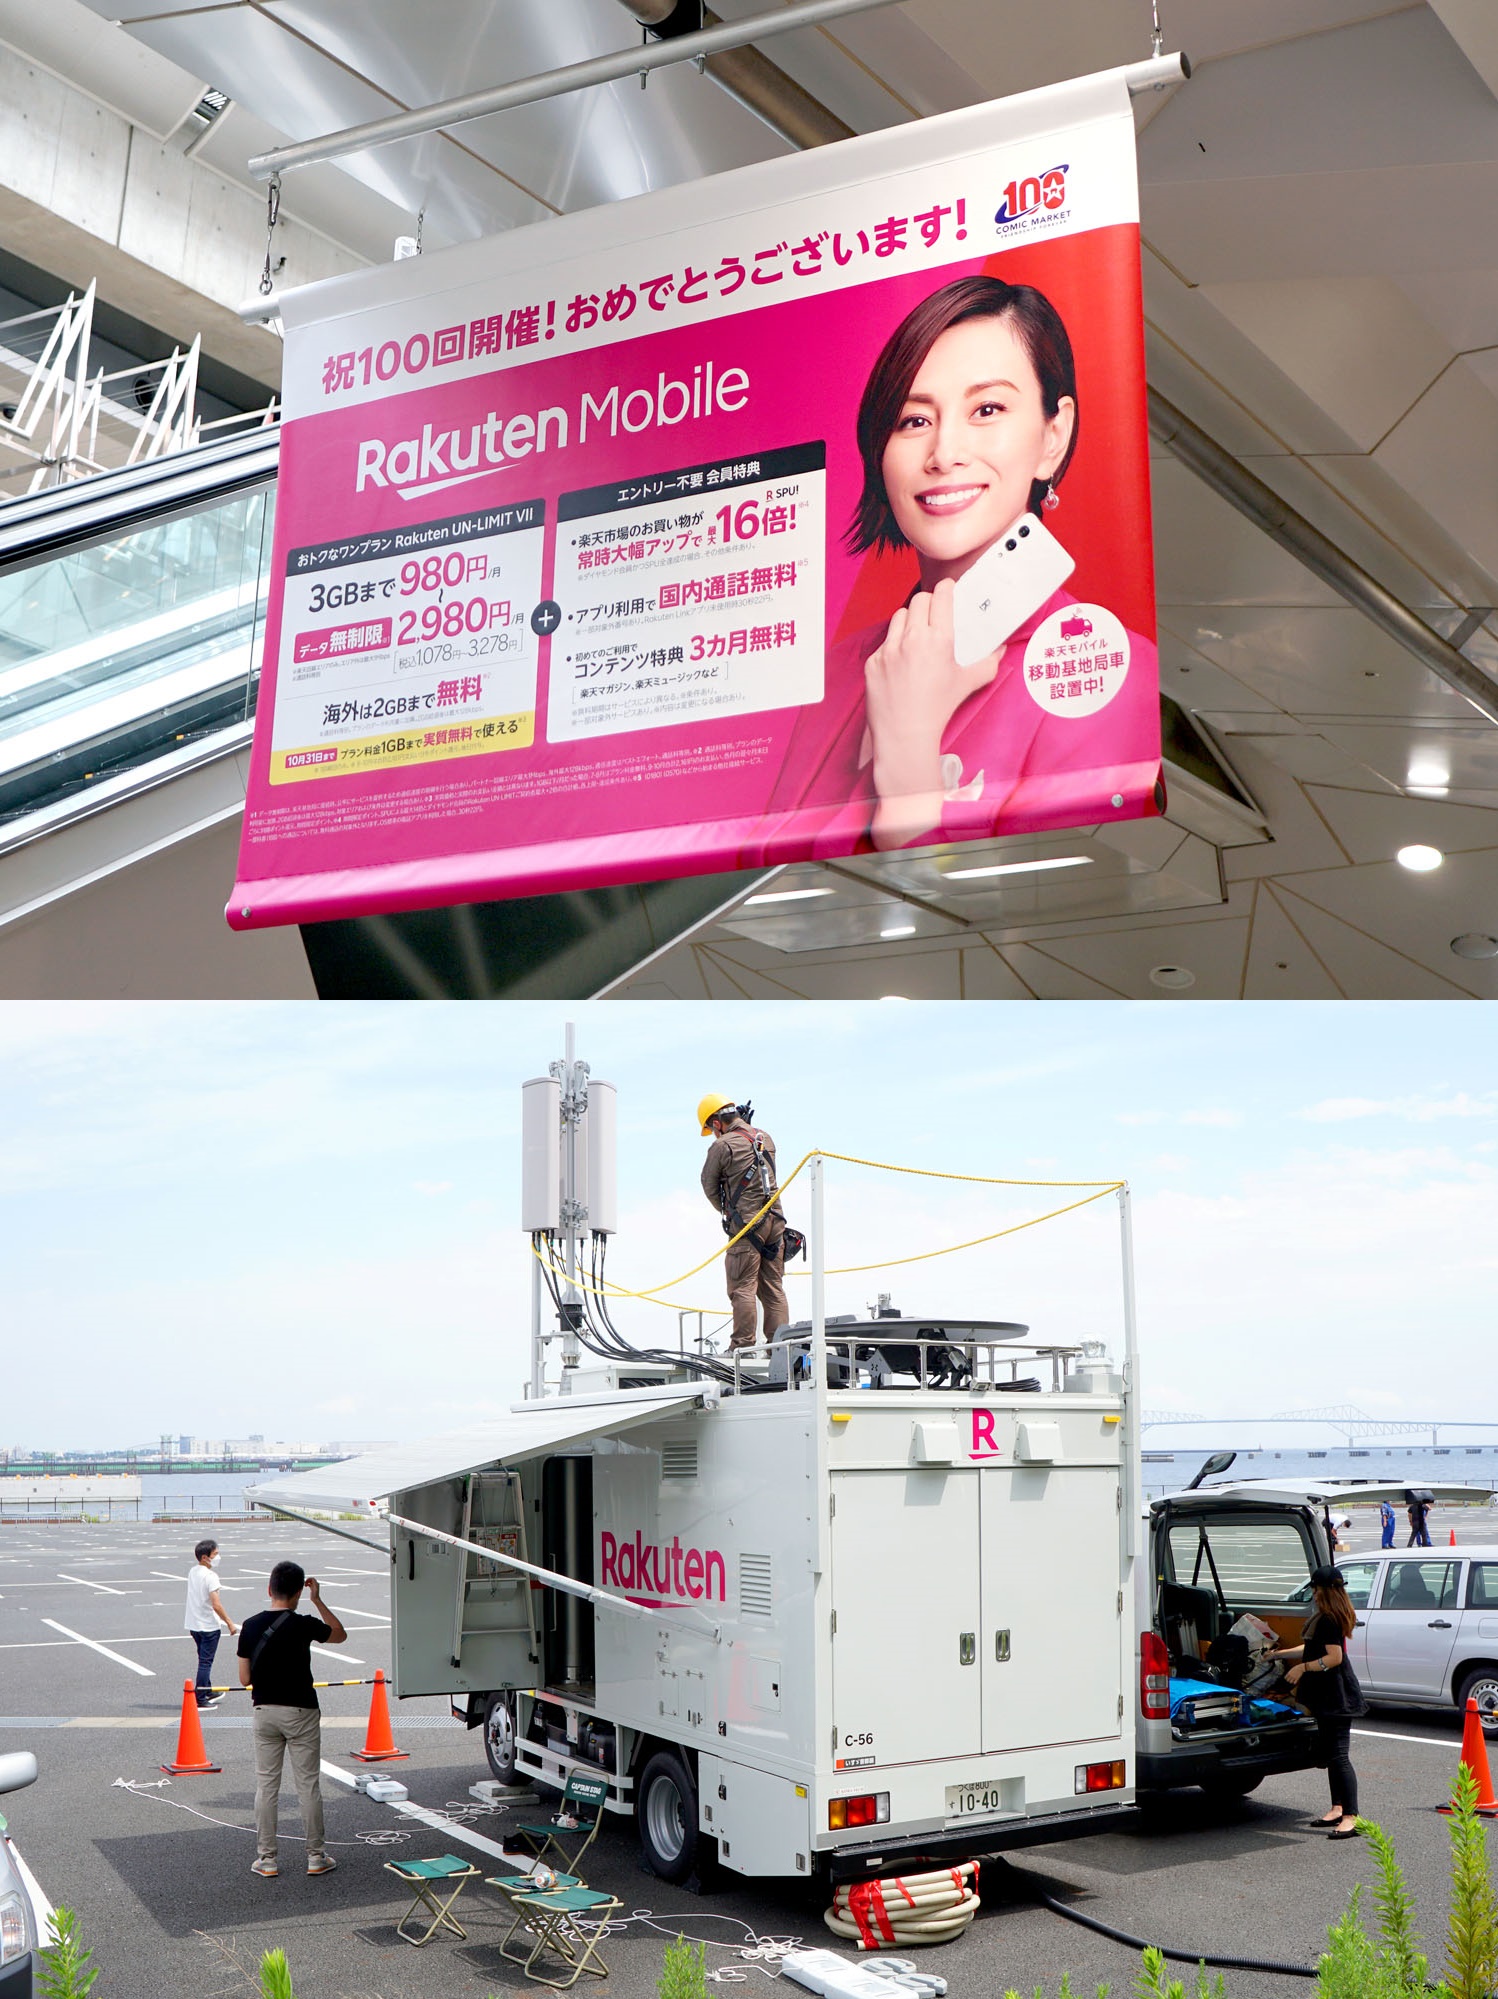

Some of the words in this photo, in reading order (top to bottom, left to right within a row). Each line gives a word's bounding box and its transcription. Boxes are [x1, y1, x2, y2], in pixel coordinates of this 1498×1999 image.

[996, 220, 1028, 235] COMIC
[1031, 210, 1072, 226] MARKET
[355, 404, 569, 494] Rakuten
[578, 361, 751, 444] Mobile
[617, 471, 703, 502] エントリー不要
[706, 461, 761, 485] 会員特典
[776, 485, 799, 499] SPU!
[297, 537, 393, 568] おトクなワンプラン
[395, 526, 449, 549] Rakuten
[452, 510, 514, 536] UN-LIMIT
[516, 507, 533, 524] VII
[575, 643, 639, 662] 初めてのご利用で
[1044, 638, 1108, 659] 楽天モバイル
[574, 646, 684, 679] コンテンツ特典
[1028, 651, 1125, 682] 移動基地局車
[1050, 675, 1104, 700] 設置中!
[286, 752, 335, 767] 10月31日まで
[972, 1408, 1000, 1452] R
[601, 1530, 726, 1602] Rakuten
[844, 1732, 874, 1747] C-56
[960, 1790, 999, 1812] 10-40
